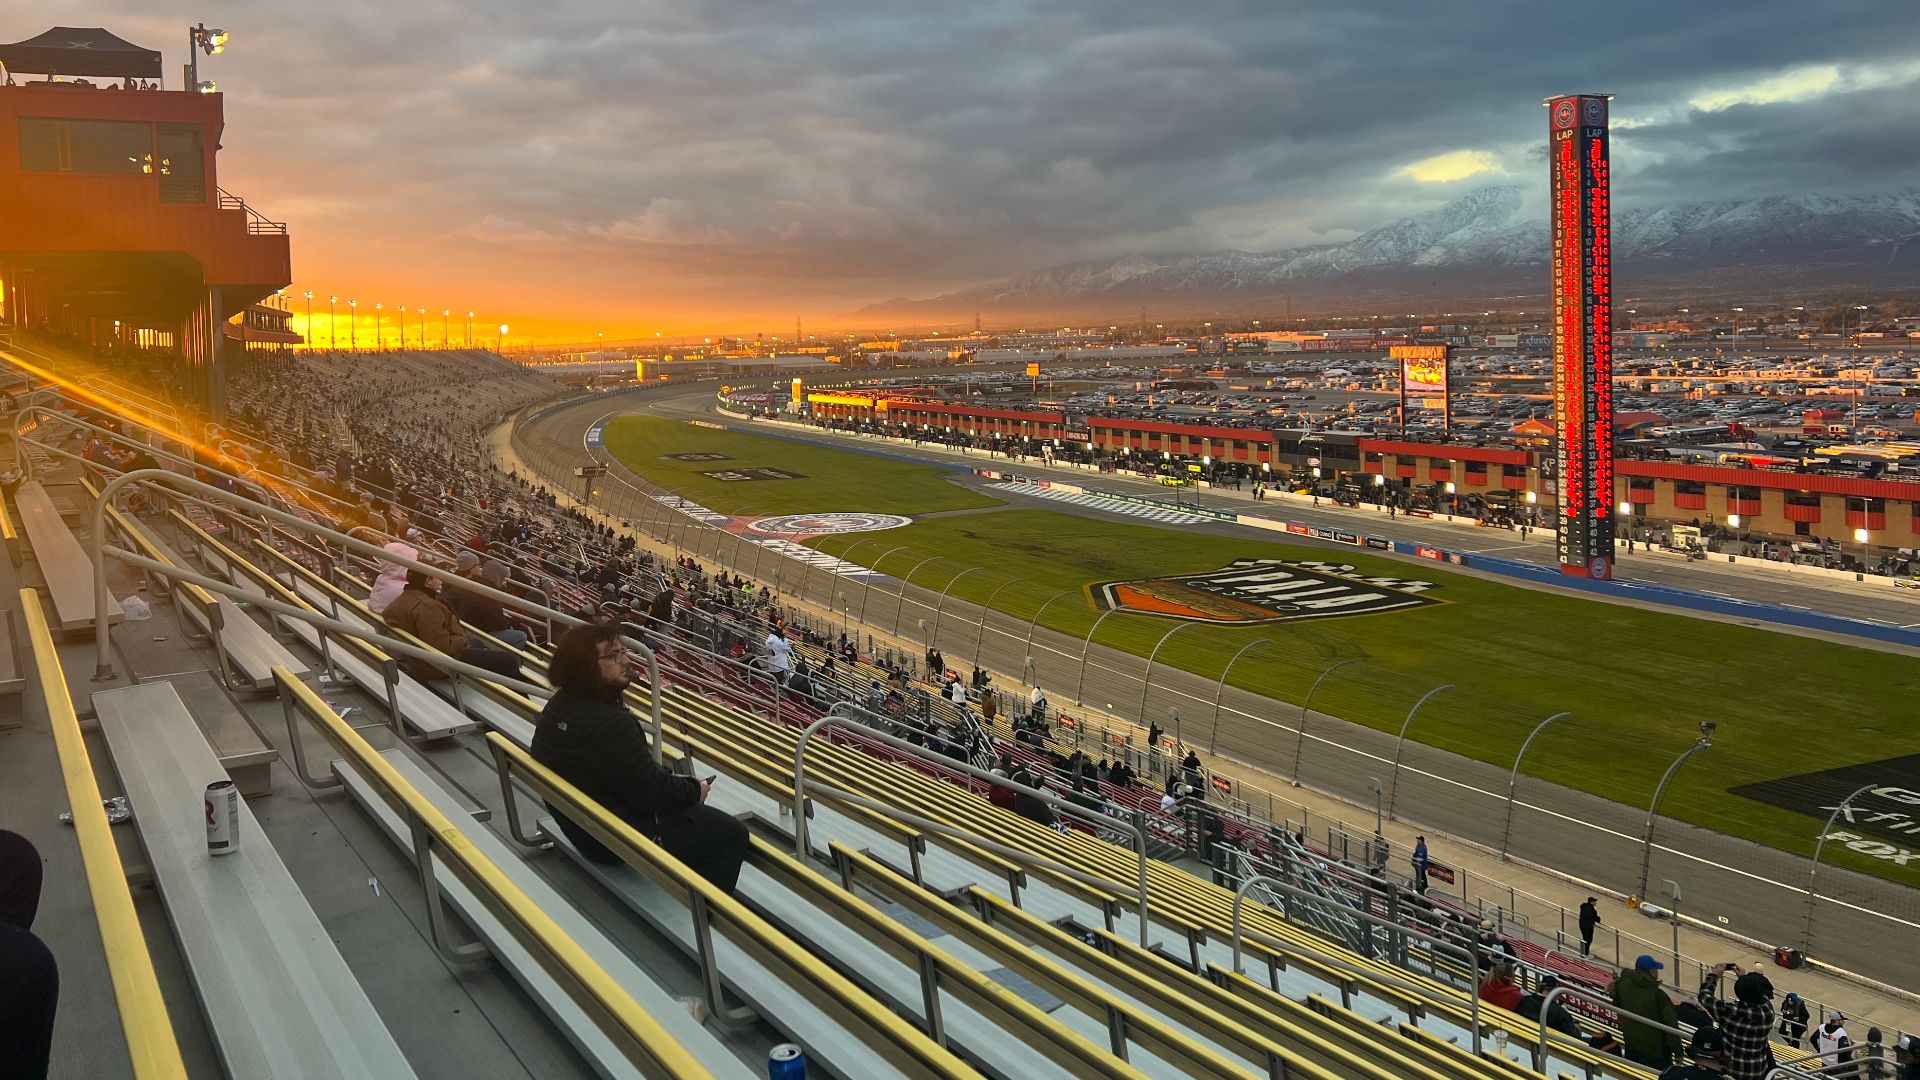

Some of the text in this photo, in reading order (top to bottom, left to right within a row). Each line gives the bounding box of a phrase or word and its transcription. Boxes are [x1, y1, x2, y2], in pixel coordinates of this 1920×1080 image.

[1557, 130, 1573, 140] LAP
[1586, 128, 1602, 138] LAP
[1306, 340, 1334, 349] KING TACO
[1526, 336, 1551, 346] xfinity
[1557, 393, 1565, 401] 26
[1558, 431, 1566, 439] 30
[1559, 450, 1566, 458] 32
[1559, 469, 1567, 477] 34
[1560, 507, 1567, 515] 38
[1560, 517, 1568, 525] 39
[1560, 536, 1567, 544] 41
[1560, 546, 1568, 554] 42
[1560, 555, 1568, 564] 43
[1186, 581, 1300, 611] CASINO
[1605, 1008, 1618, 1020] 35
[1821, 1032, 1837, 1042] FedEx
